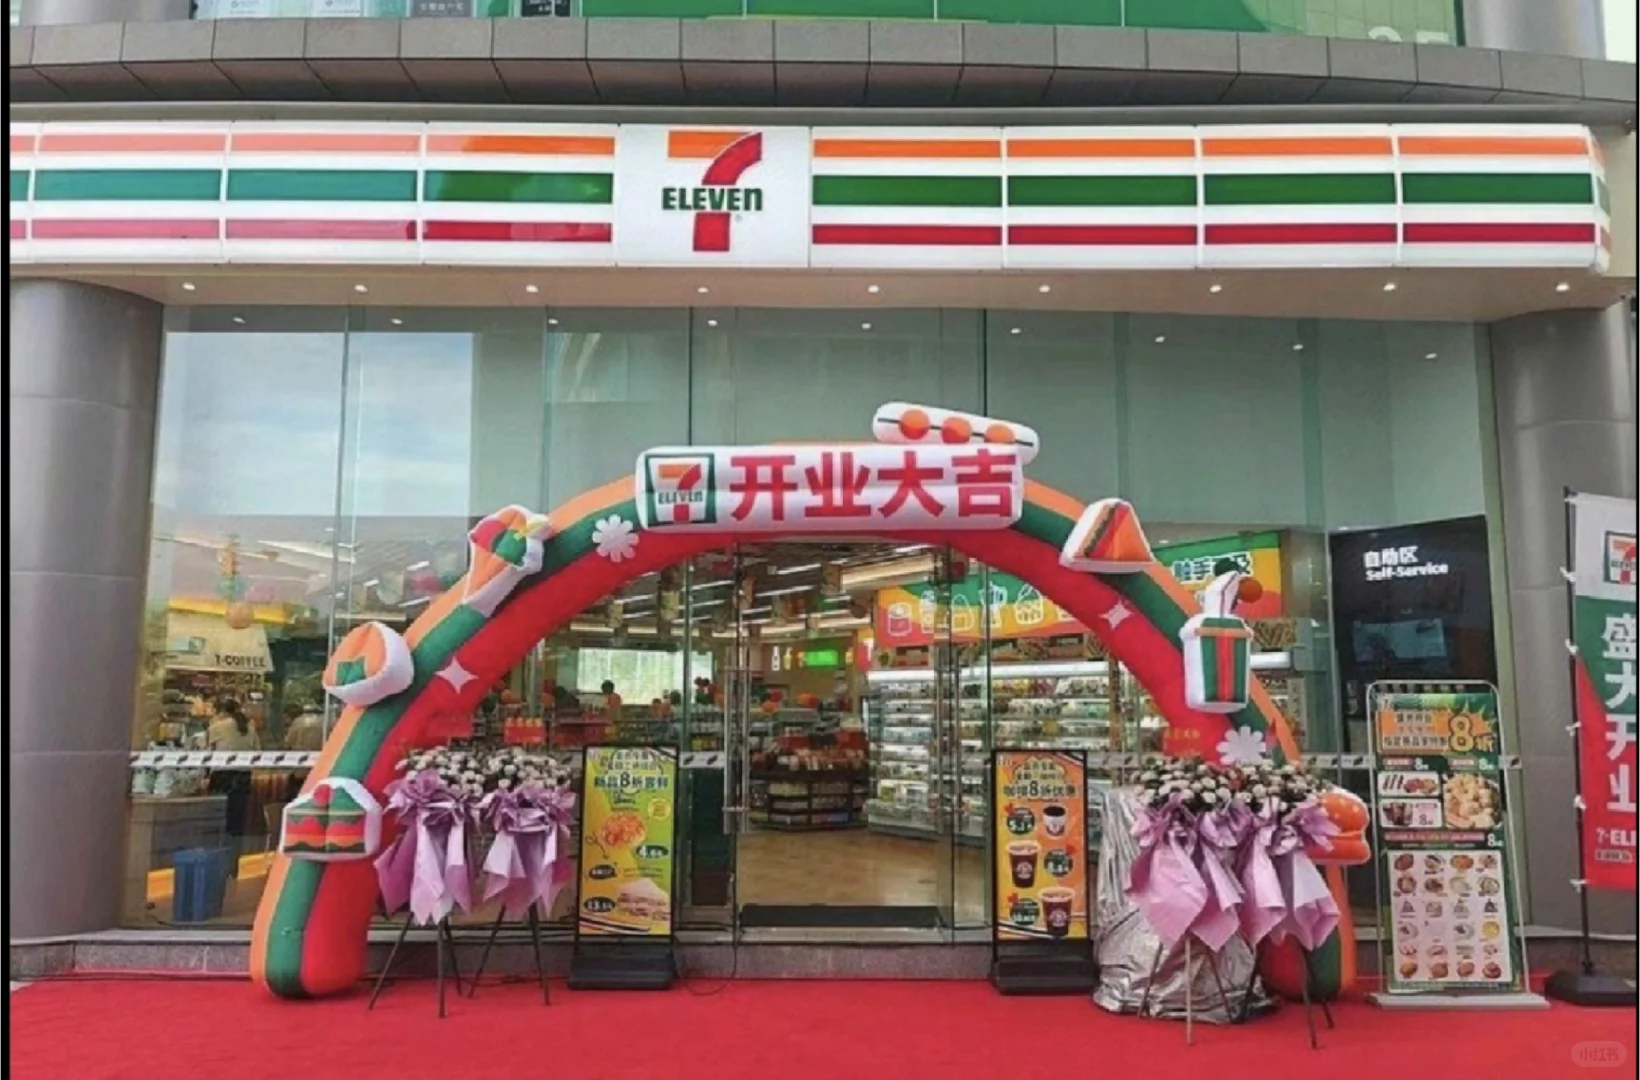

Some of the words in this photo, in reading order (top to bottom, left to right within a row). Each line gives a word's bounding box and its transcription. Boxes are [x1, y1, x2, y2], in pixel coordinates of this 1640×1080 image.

[661, 187, 763, 211] ELEVEn
[667, 131, 762, 252] 7
[658, 463, 702, 522] 7
[730, 448, 1016, 521] 开业大吉
[1172, 551, 1253, 584] 触手及
[1364, 546, 1419, 568] 自助区
[1366, 561, 1448, 581] Self-Service
